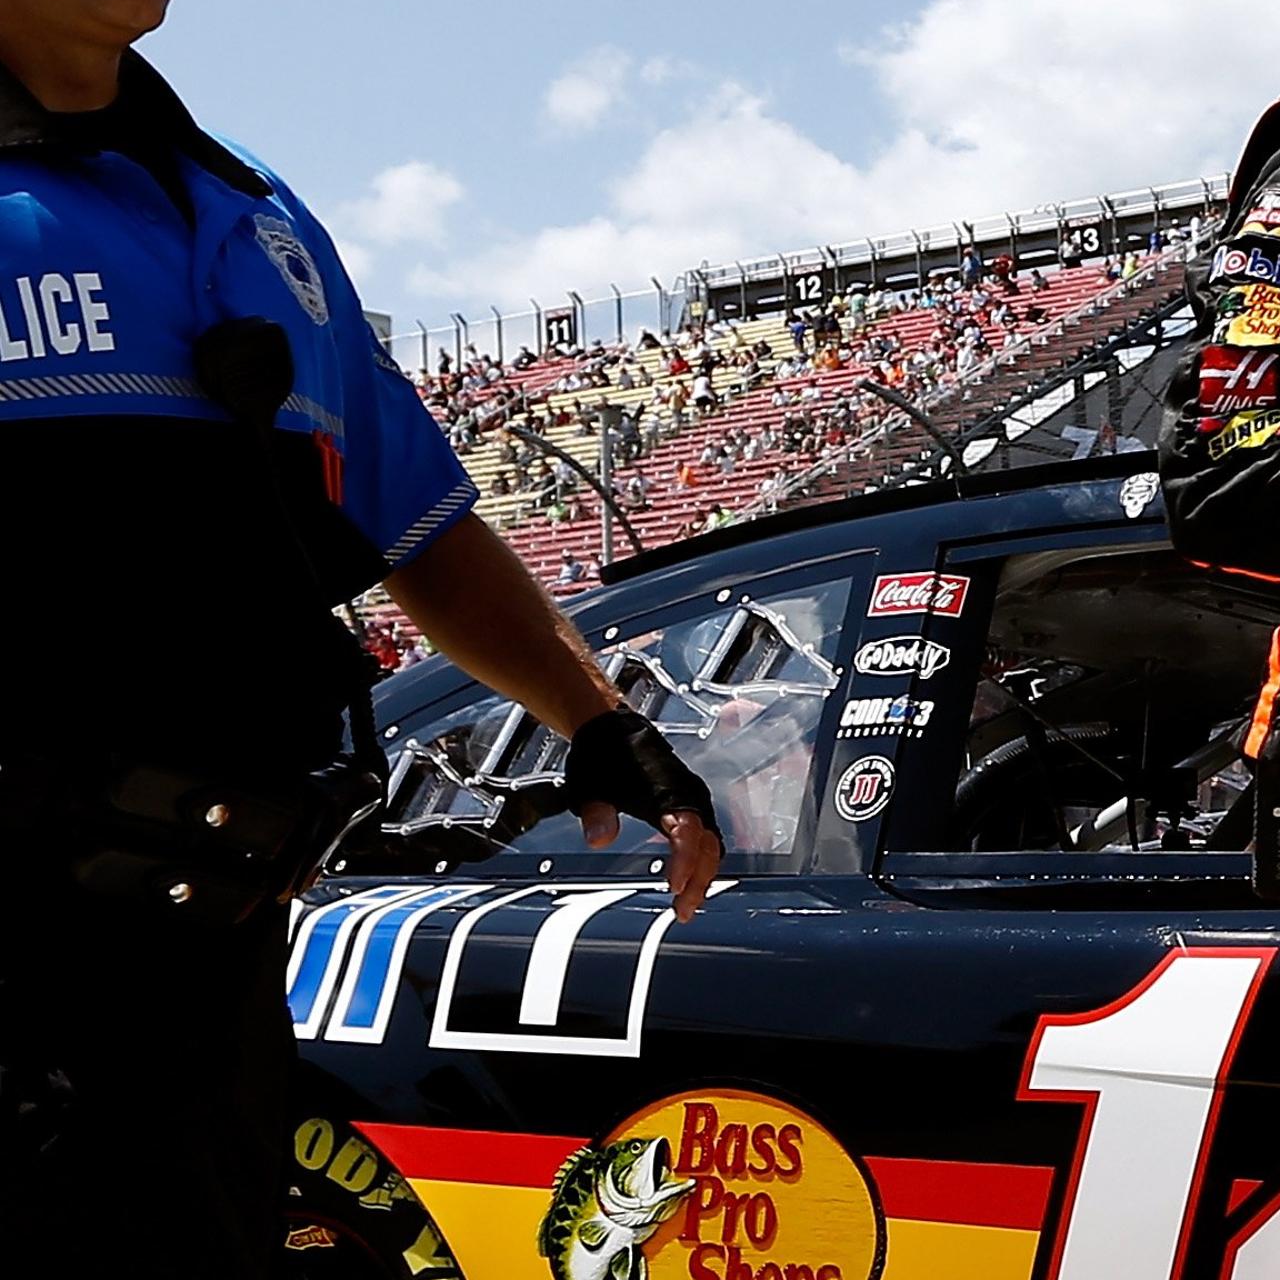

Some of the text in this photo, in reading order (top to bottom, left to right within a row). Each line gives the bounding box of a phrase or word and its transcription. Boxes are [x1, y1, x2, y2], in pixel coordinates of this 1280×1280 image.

[1075, 226, 1099, 252] 13
[795, 275, 822, 301] 12
[1246, 300, 1280, 320] Pro
[549, 320, 572, 345] 11
[840, 698, 934, 727] CODE 3
[673, 1101, 806, 1185] Bass
[677, 1175, 780, 1252] Pro
